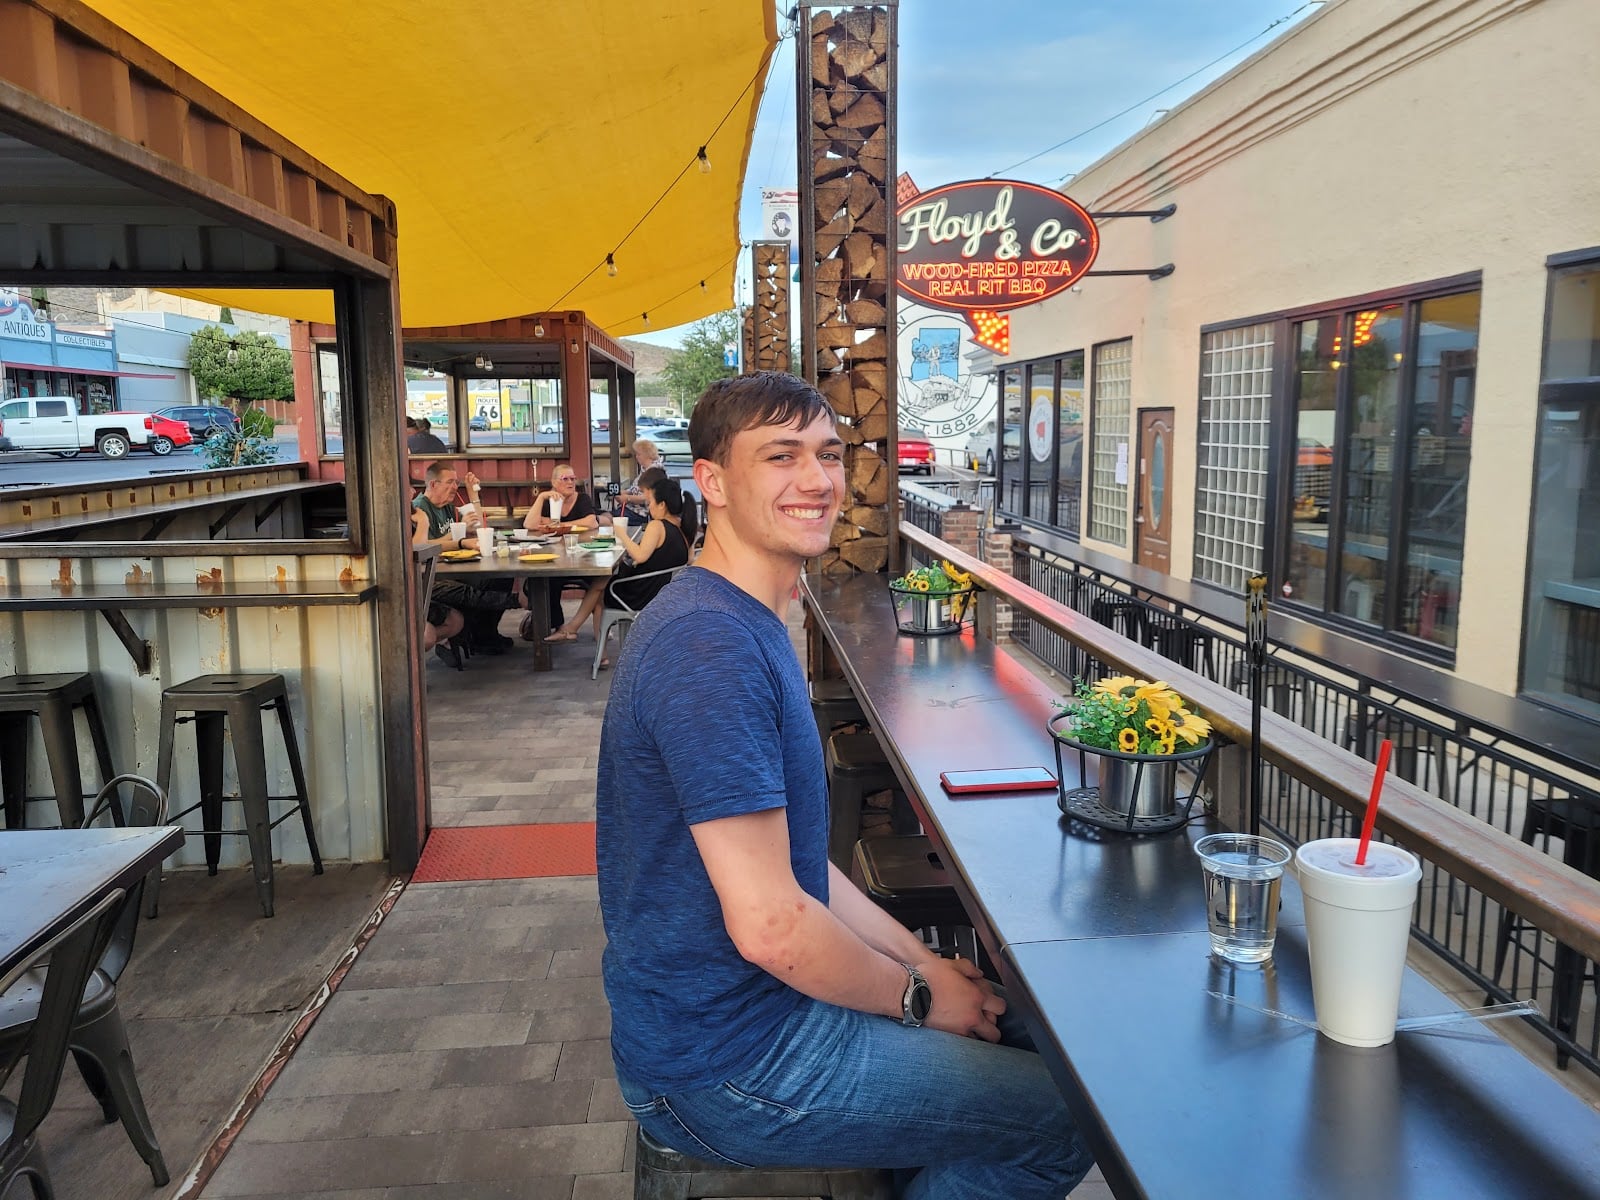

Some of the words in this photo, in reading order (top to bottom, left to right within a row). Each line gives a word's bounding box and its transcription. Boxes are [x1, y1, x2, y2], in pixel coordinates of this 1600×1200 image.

[897, 185, 1015, 258] Floyd
[995, 228, 1021, 260] &
[1030, 218, 1087, 257] Co.
[903, 262, 1017, 280] WOOD-FIRED
[1022, 260, 1072, 277] PIZZA
[929, 279, 974, 296] REAL
[978, 279, 1005, 295] PIT
[1009, 278, 1046, 295] BBQ
[4, 320, 46, 338] ANTIQUES
[63, 335, 106, 348] COLLECTIBLES
[479, 405, 498, 419] 66
[898, 411, 930, 435] EST.
[936, 413, 978, 436] 1882
[608, 483, 619, 495] 59
